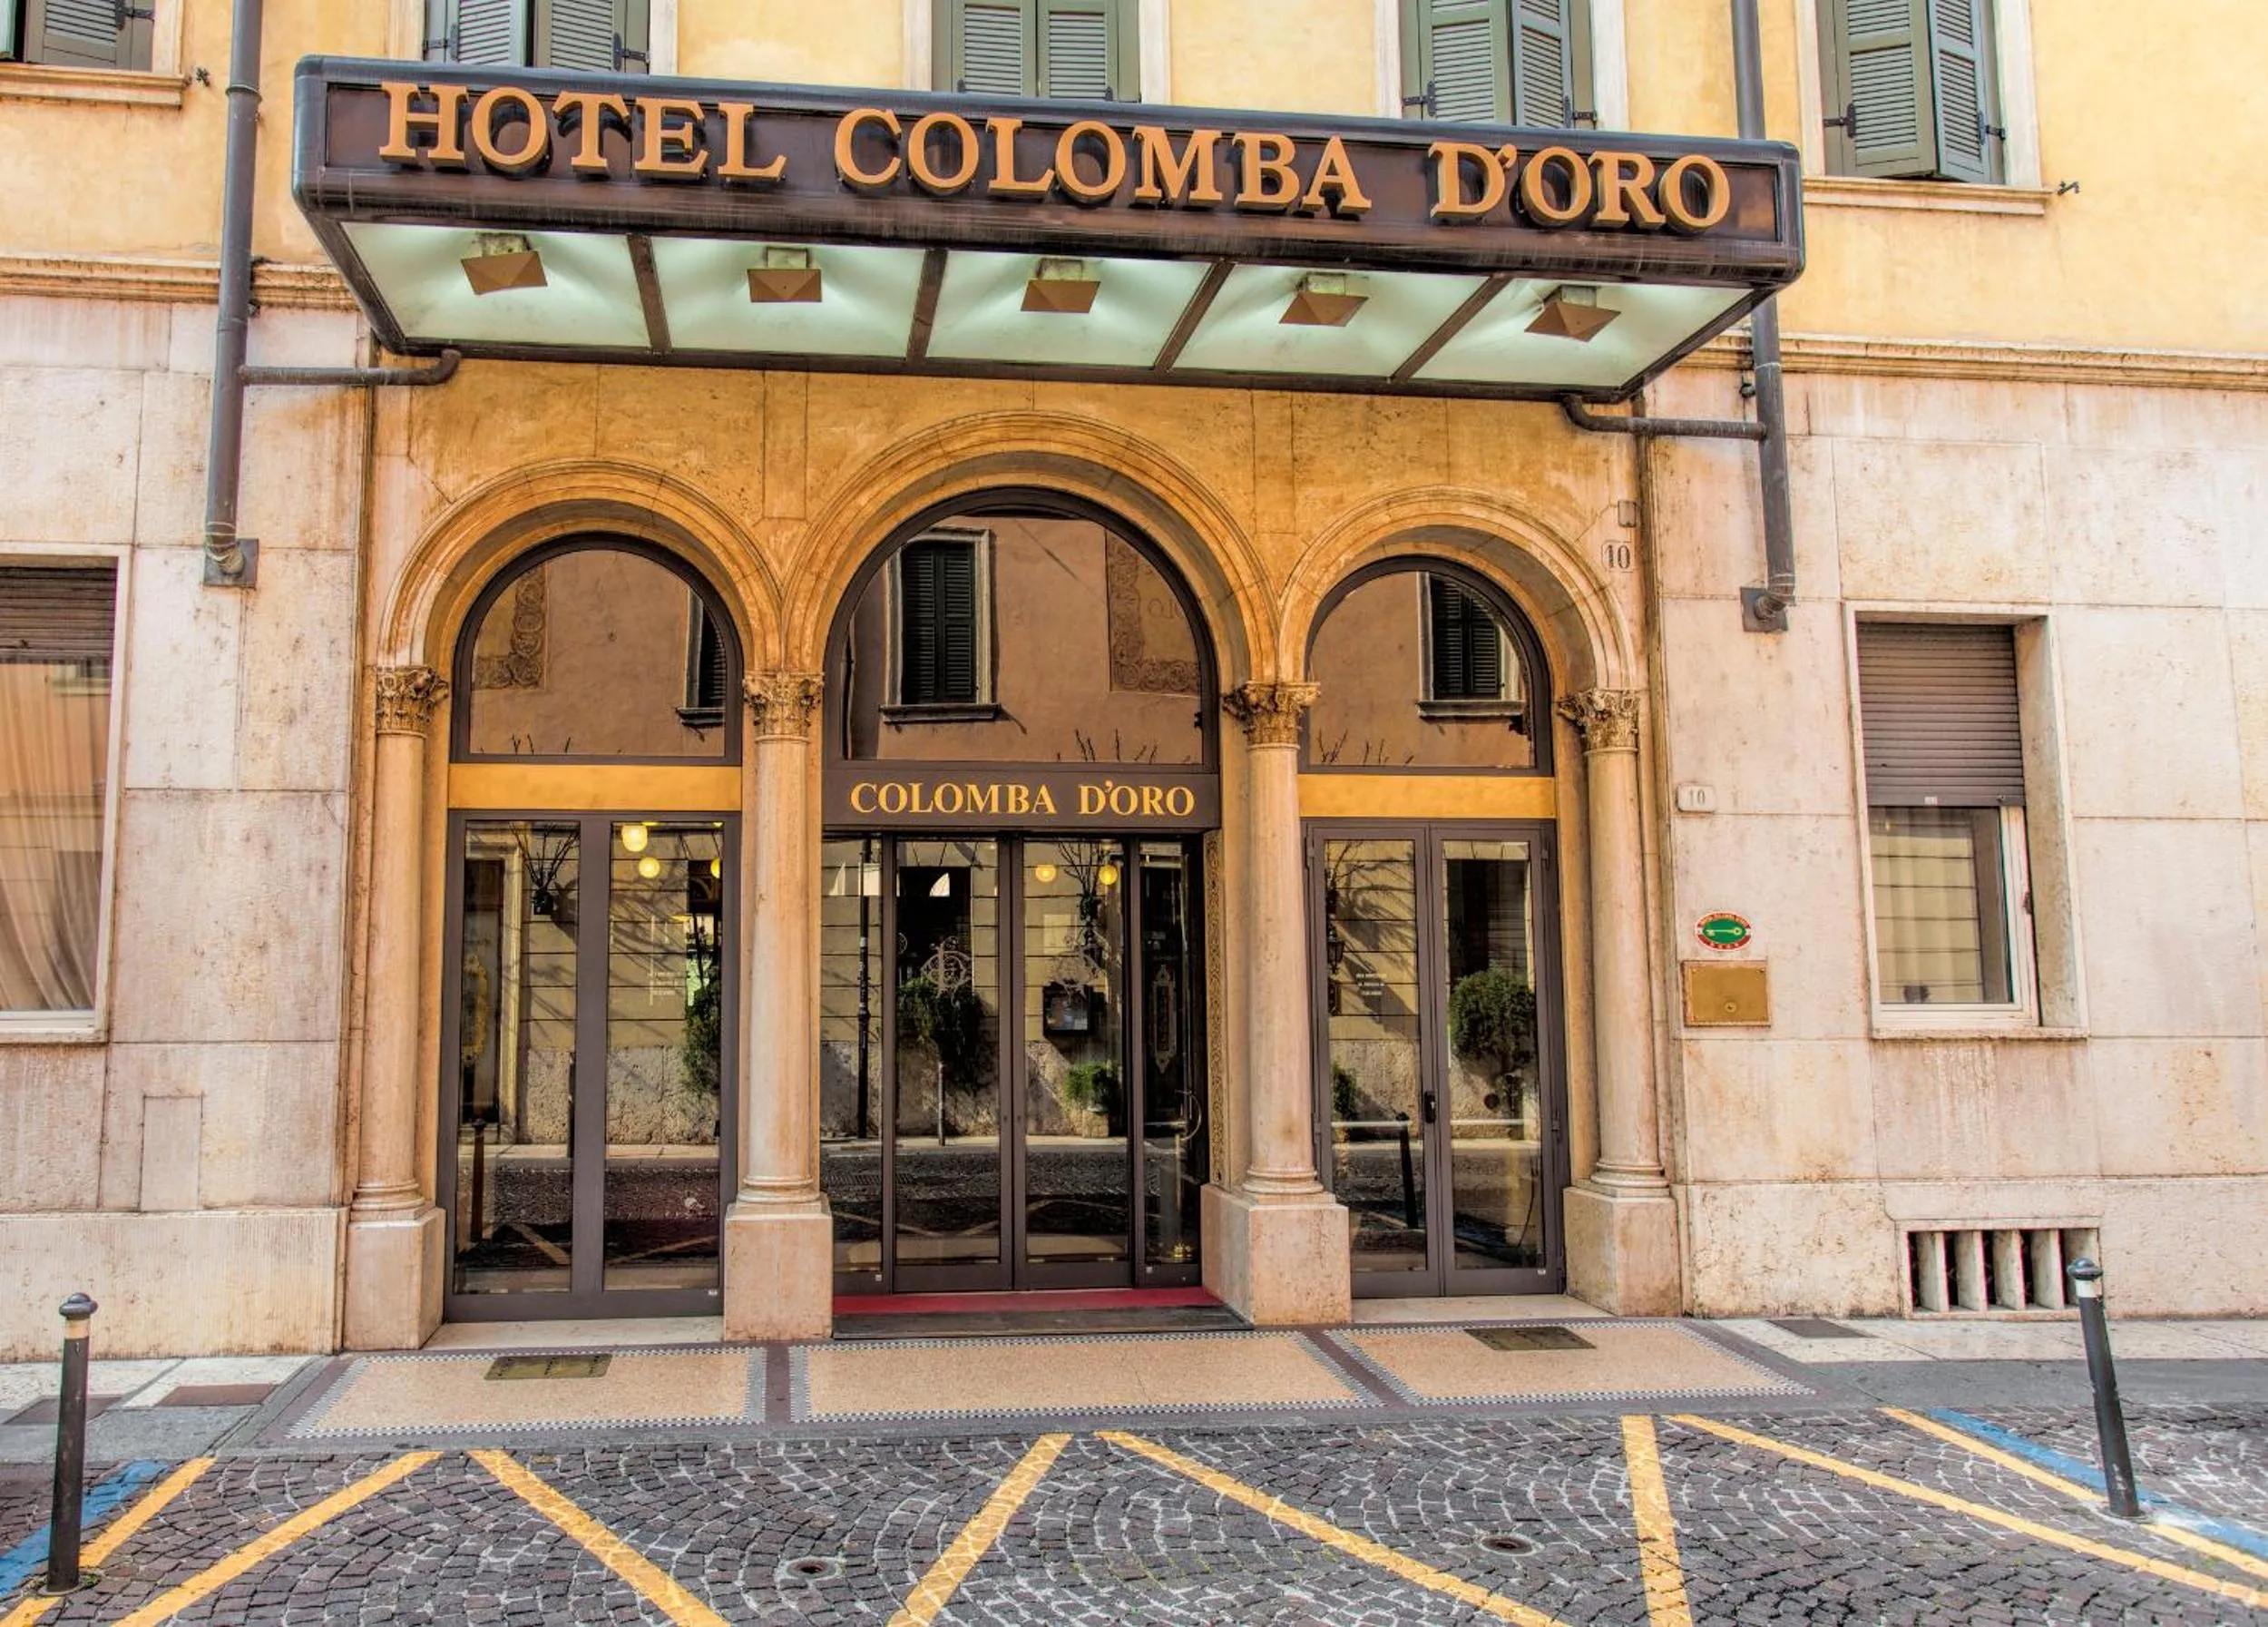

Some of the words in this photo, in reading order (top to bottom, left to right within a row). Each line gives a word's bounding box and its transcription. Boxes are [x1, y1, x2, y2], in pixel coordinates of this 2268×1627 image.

[379, 82, 786, 181] HOTEL
[834, 108, 1371, 212] COLOMBA
[1429, 141, 1731, 233] D'ORO
[1604, 544, 1631, 570] 10
[849, 782, 1057, 815] COLOMBA
[1078, 779, 1195, 816] D'ORO
[1689, 789, 1706, 806] 10
